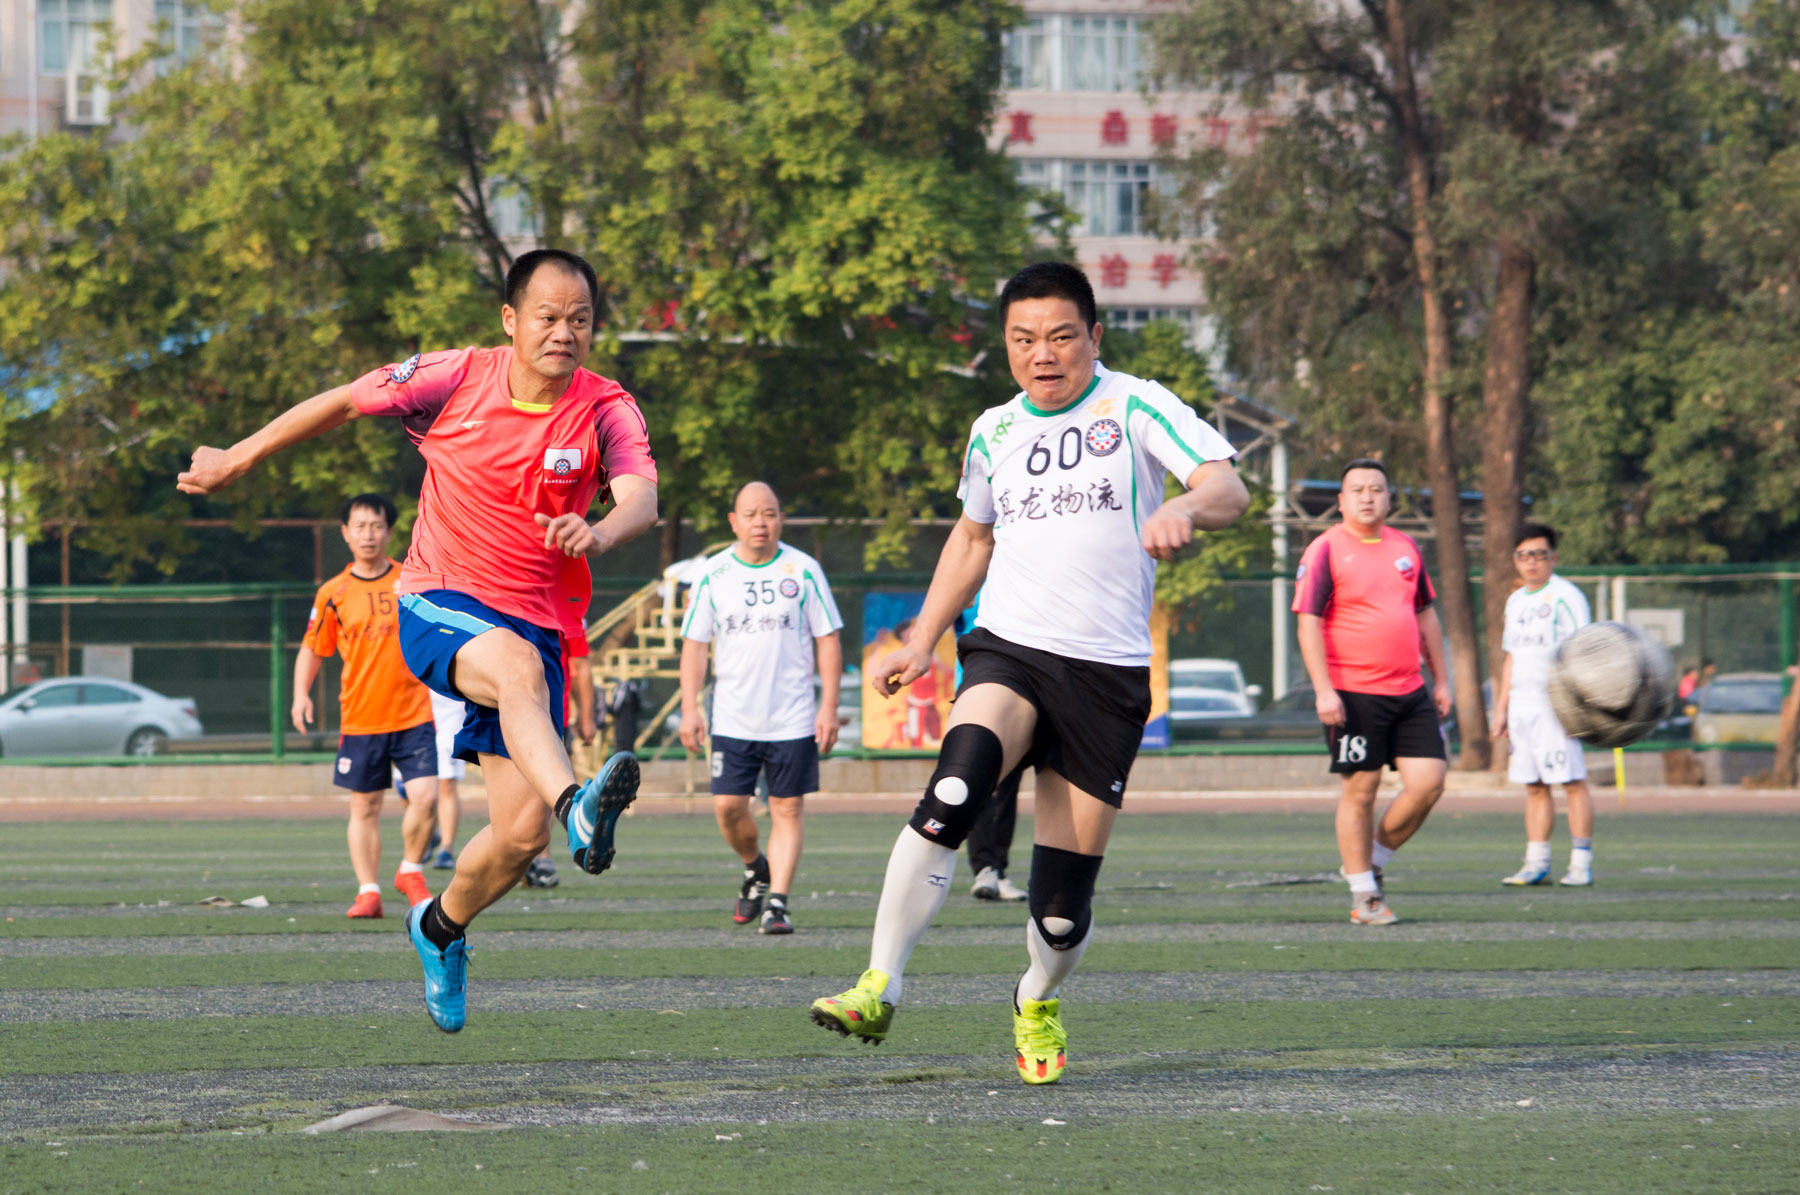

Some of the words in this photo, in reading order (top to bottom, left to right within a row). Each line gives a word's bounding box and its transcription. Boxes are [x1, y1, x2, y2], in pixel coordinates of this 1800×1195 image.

[1026, 426, 1082, 476] 60
[367, 592, 393, 615] 15
[743, 580, 775, 607] 35
[1336, 734, 1367, 763] 18
[1544, 750, 1566, 772] 49
